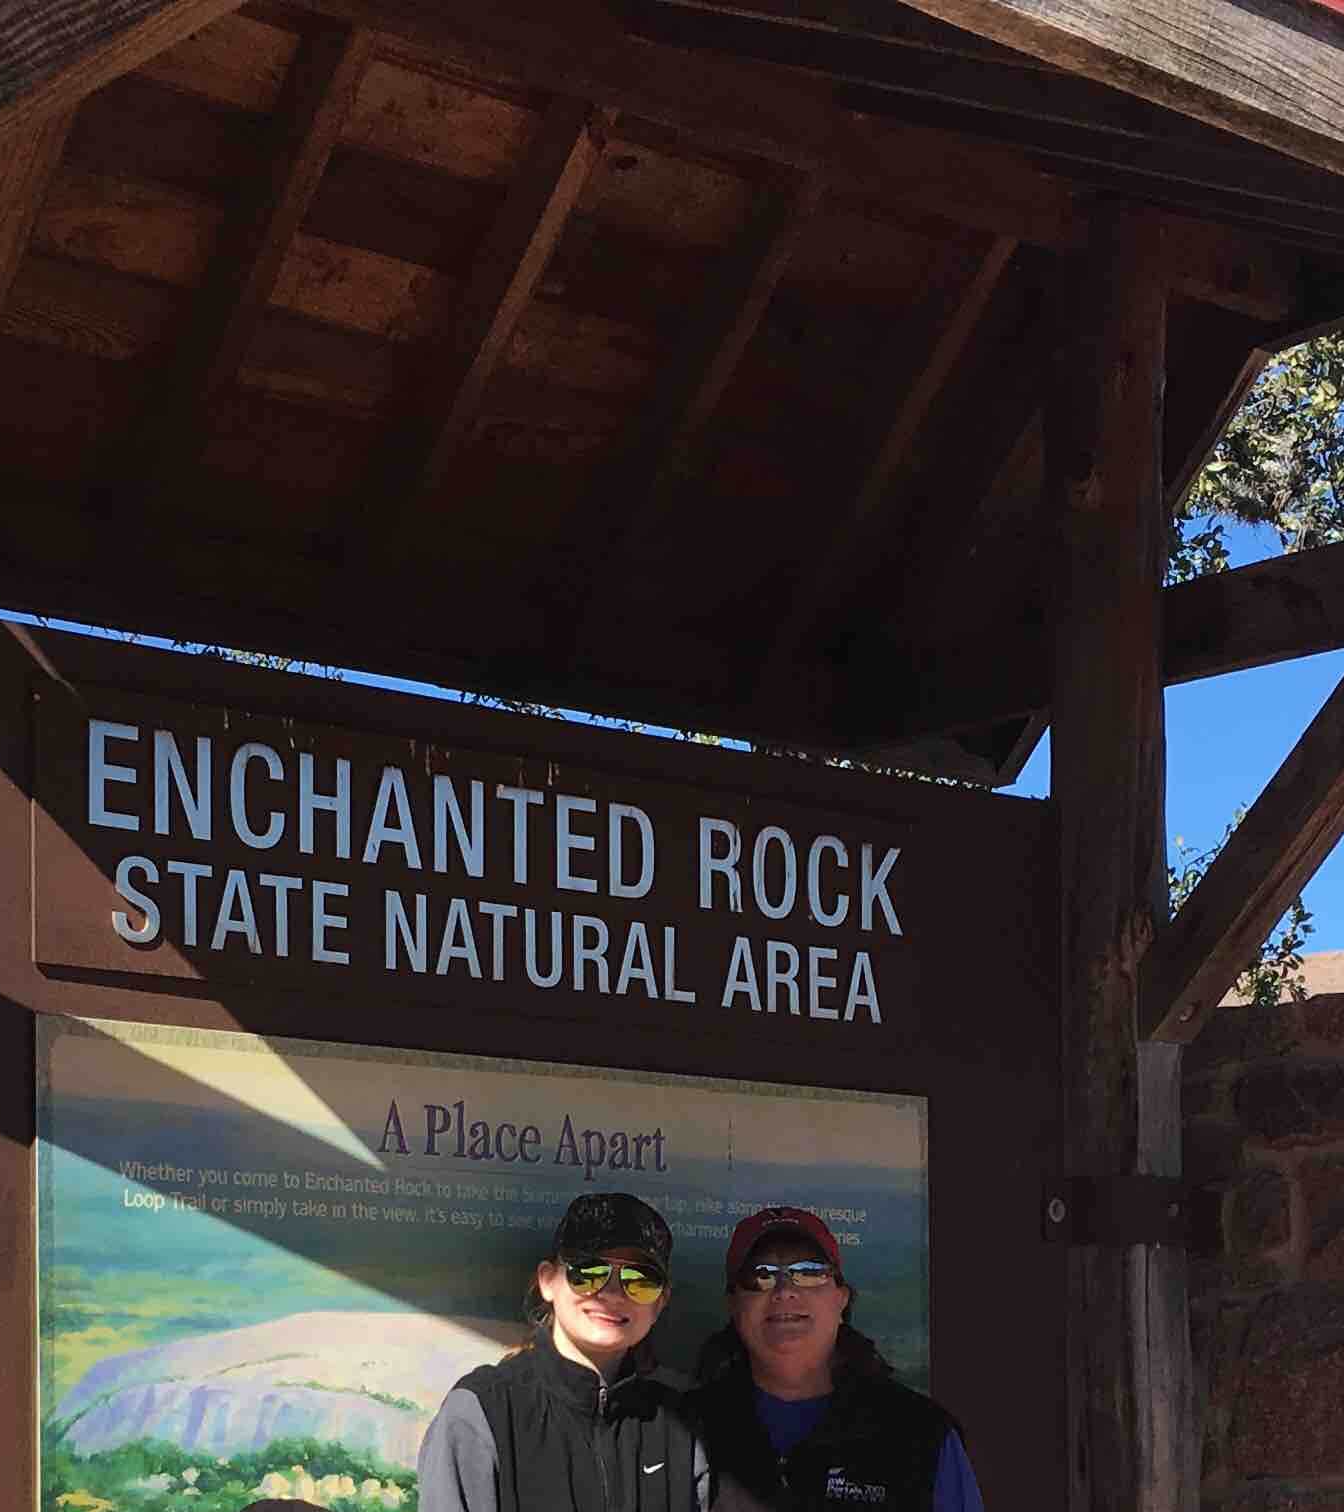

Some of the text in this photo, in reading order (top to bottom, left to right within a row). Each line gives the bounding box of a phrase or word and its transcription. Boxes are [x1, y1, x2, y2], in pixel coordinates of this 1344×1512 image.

[87, 719, 903, 936] ENCHANTED ROCK
[111, 855, 882, 1025] STATE NATURAL AREA
[119, 1161, 194, 1184] Whether
[198, 1168, 228, 1188] you
[232, 1170, 277, 1188] come
[283, 1171, 300, 1189] to
[304, 1172, 390, 1195] Enchanted
[394, 1177, 432, 1197] Rock
[377, 1098, 668, 1181] A Place Apart
[122, 1188, 165, 1213] Loop
[171, 1191, 206, 1211] Trail
[211, 1197, 229, 1213] or
[232, 1197, 287, 1222] simply
[292, 1200, 328, 1218] take
[331, 1202, 347, 1218] in
[351, 1200, 379, 1220] the
[451, 1209, 484, 1231] easy
[489, 1209, 505, 1227] to
